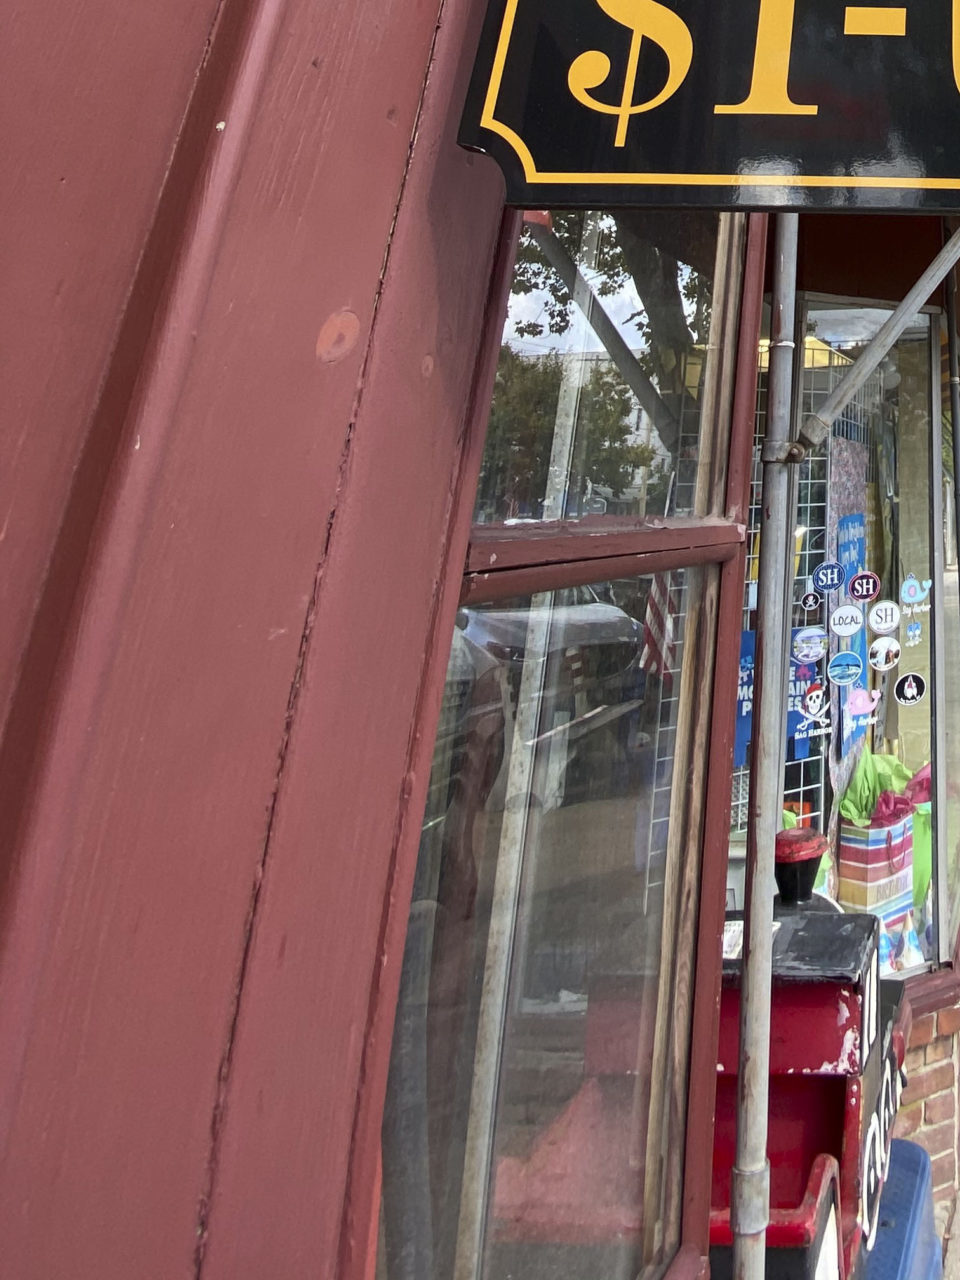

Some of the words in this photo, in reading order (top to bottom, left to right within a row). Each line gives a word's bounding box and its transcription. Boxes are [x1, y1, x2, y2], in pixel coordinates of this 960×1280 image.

[818, 569, 839, 586] SH
[854, 578, 874, 596] SH
[833, 616, 861, 626] LOCAL
[875, 607, 894, 625] SH
